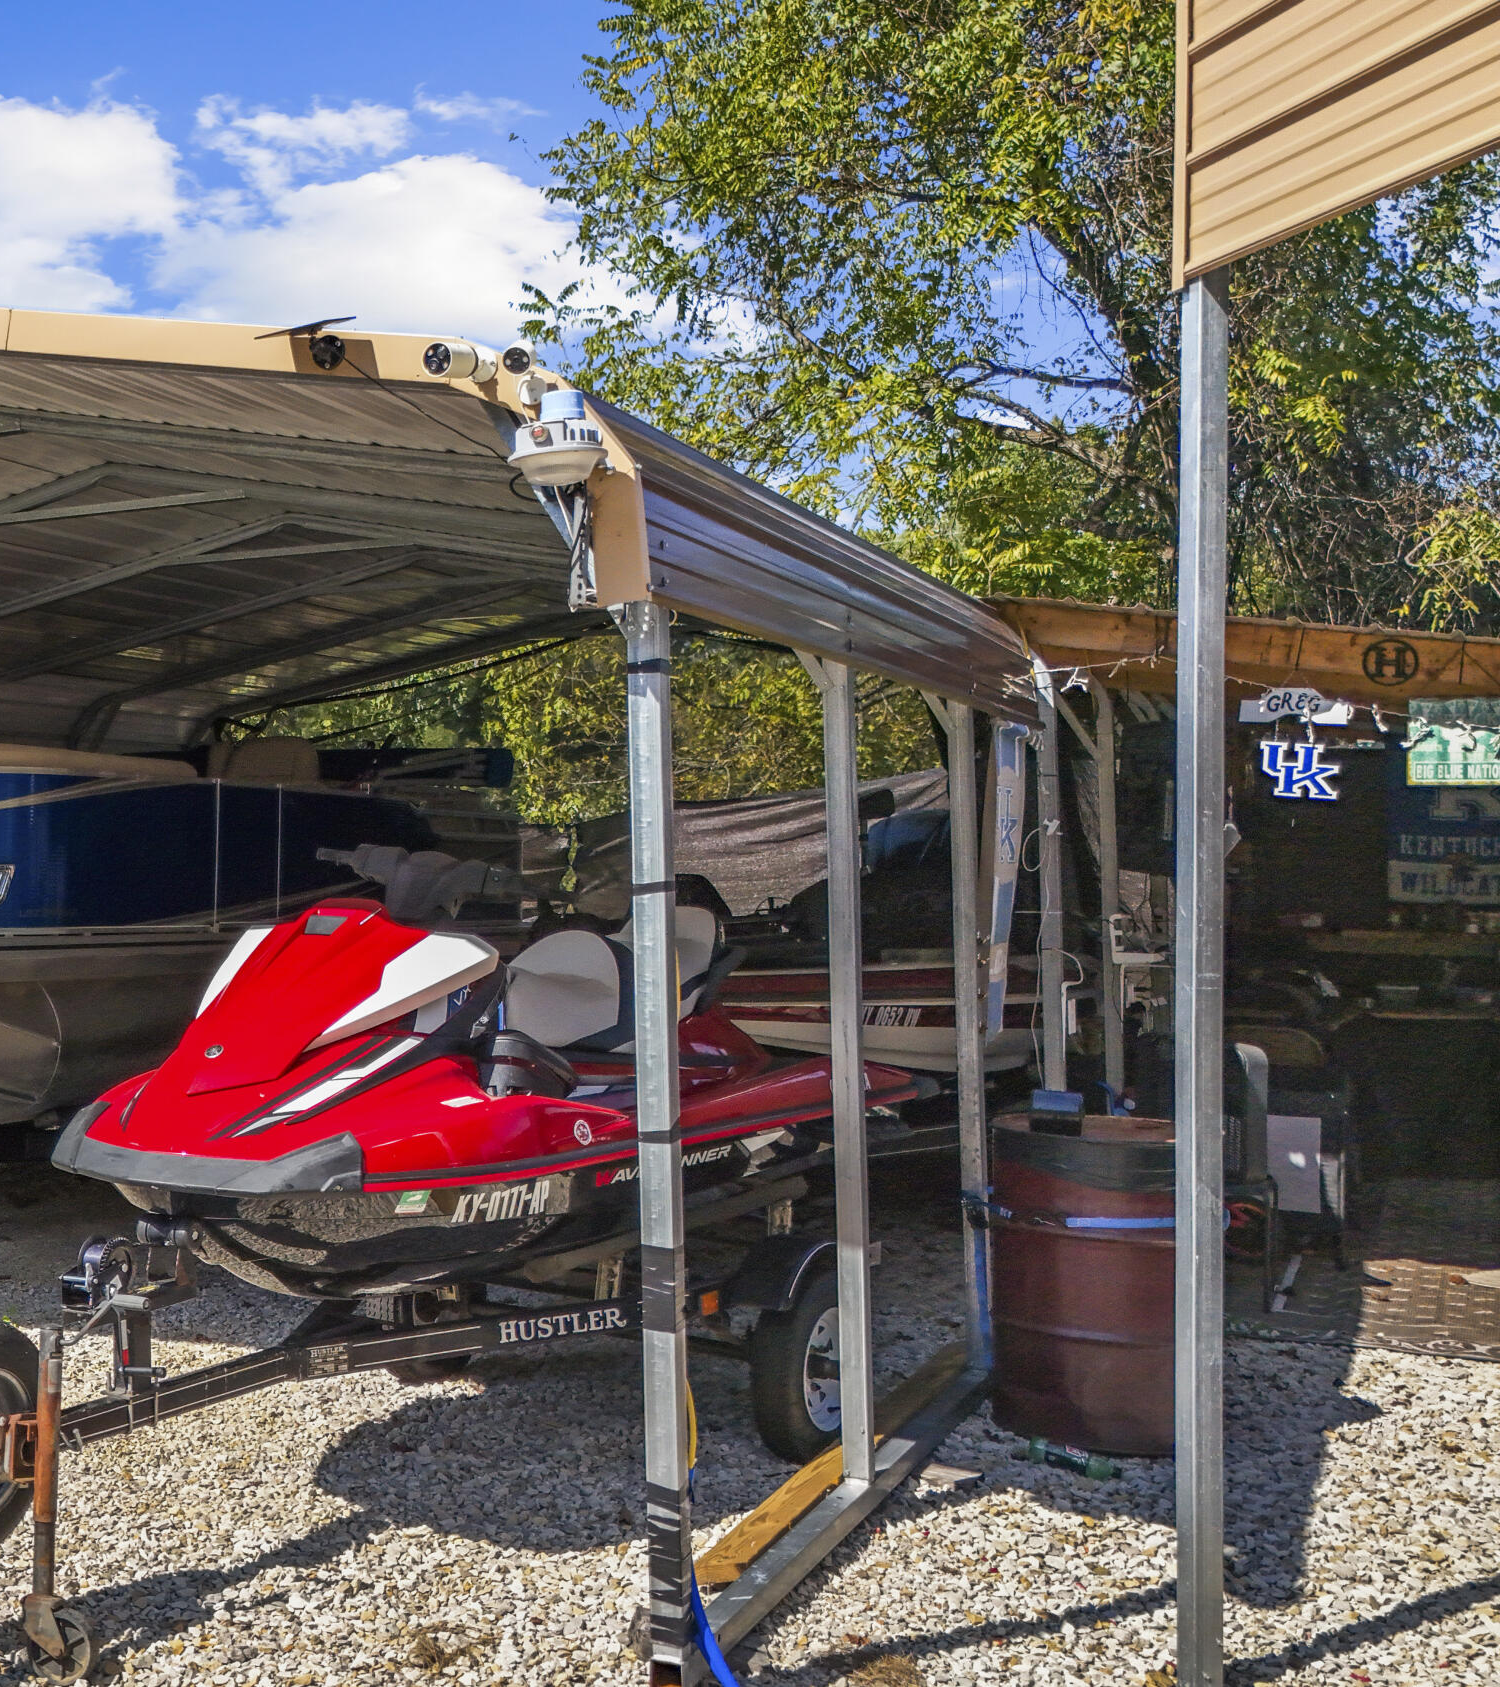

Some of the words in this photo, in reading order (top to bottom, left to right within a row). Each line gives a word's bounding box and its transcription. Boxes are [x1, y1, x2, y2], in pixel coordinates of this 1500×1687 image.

[1266, 691, 1321, 713] GREG
[1260, 740, 1339, 799] UK
[1416, 764, 1435, 779] BIG
[1437, 764, 1464, 779] BLUE
[499, 1307, 627, 1344] HUSTLER
